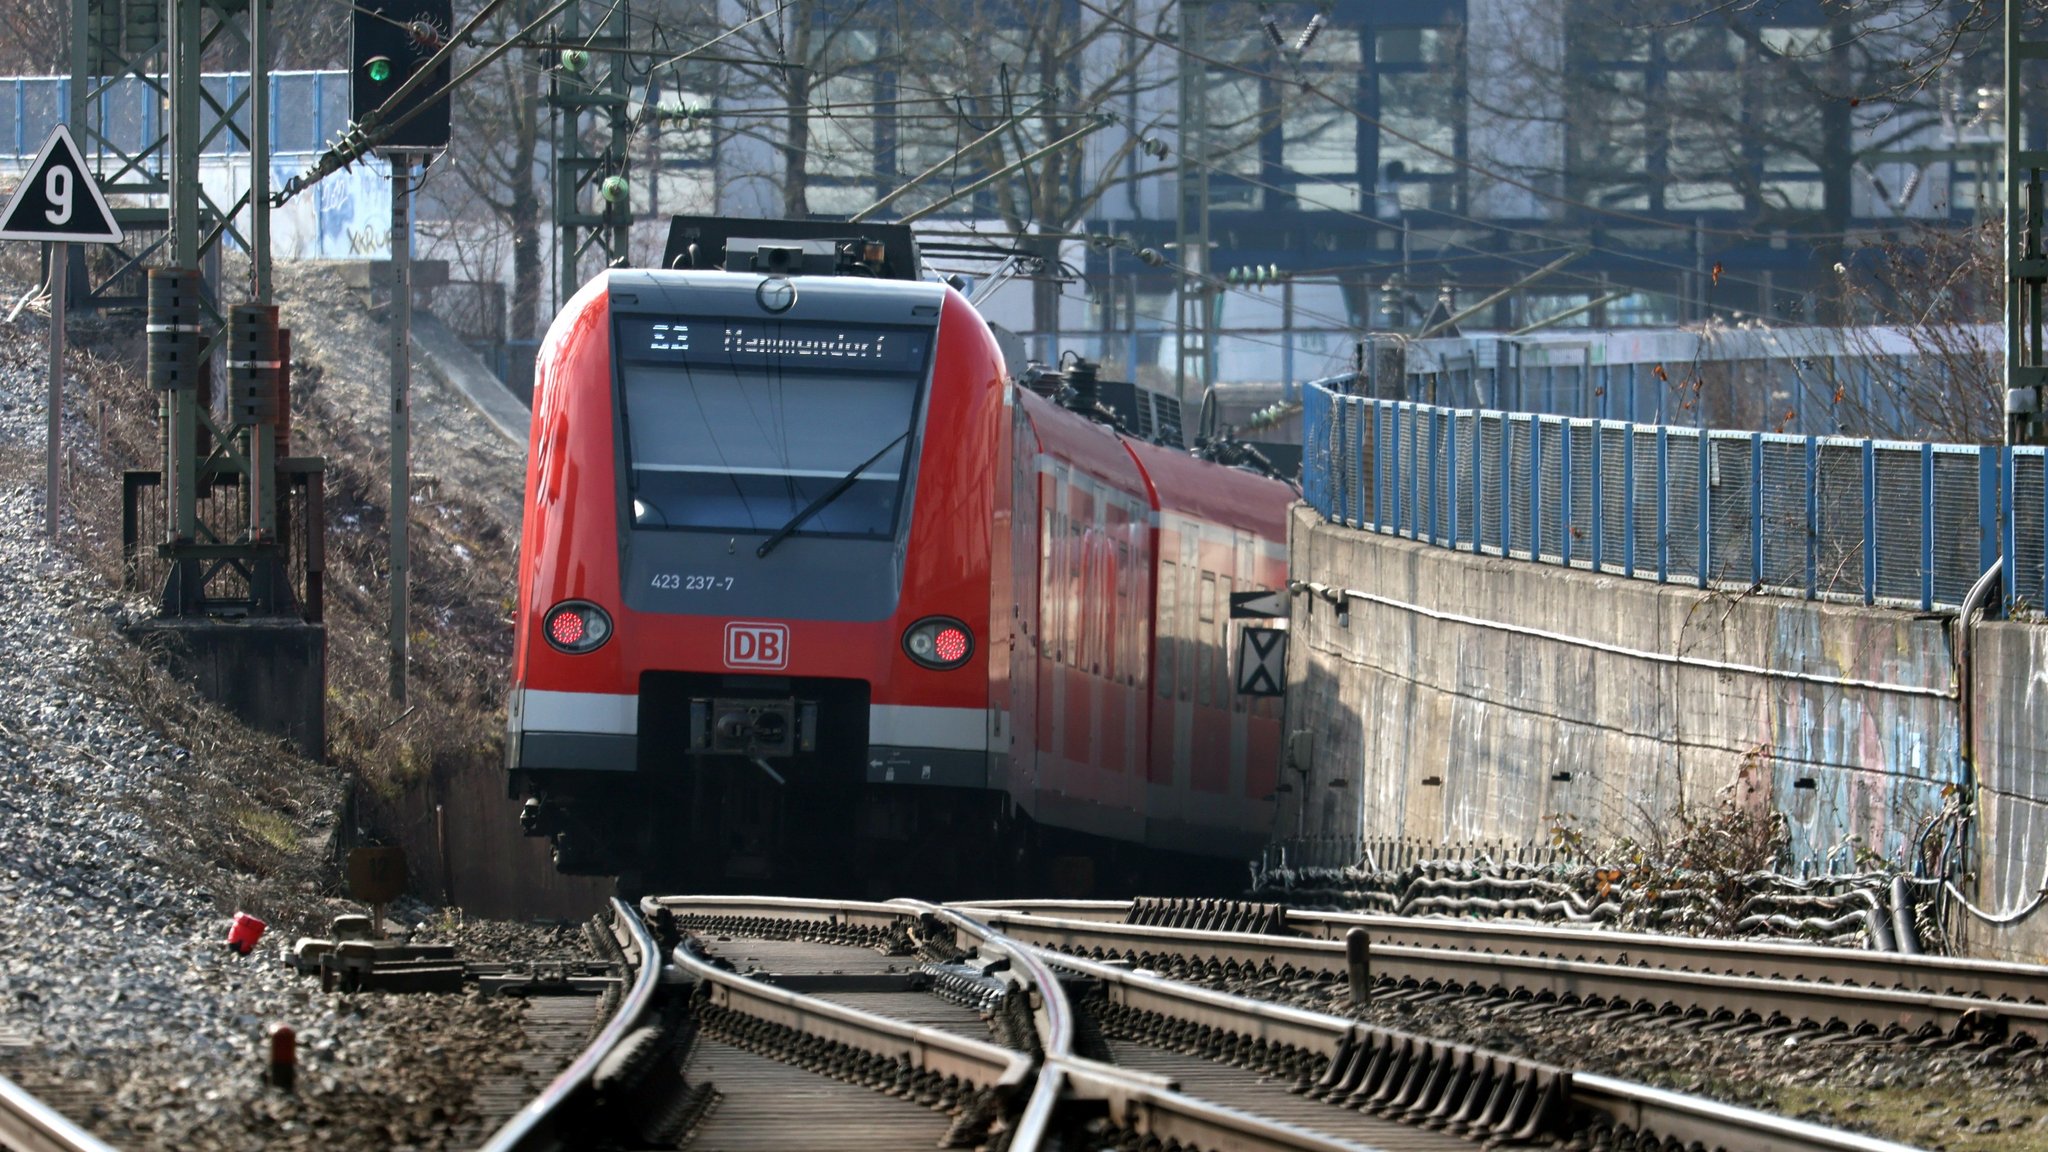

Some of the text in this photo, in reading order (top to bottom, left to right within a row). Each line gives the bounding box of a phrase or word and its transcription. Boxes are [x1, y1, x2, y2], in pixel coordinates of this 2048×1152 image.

[45, 165, 73, 225] 9
[651, 574, 734, 591] 423 237-7
[732, 630, 781, 662] DB
